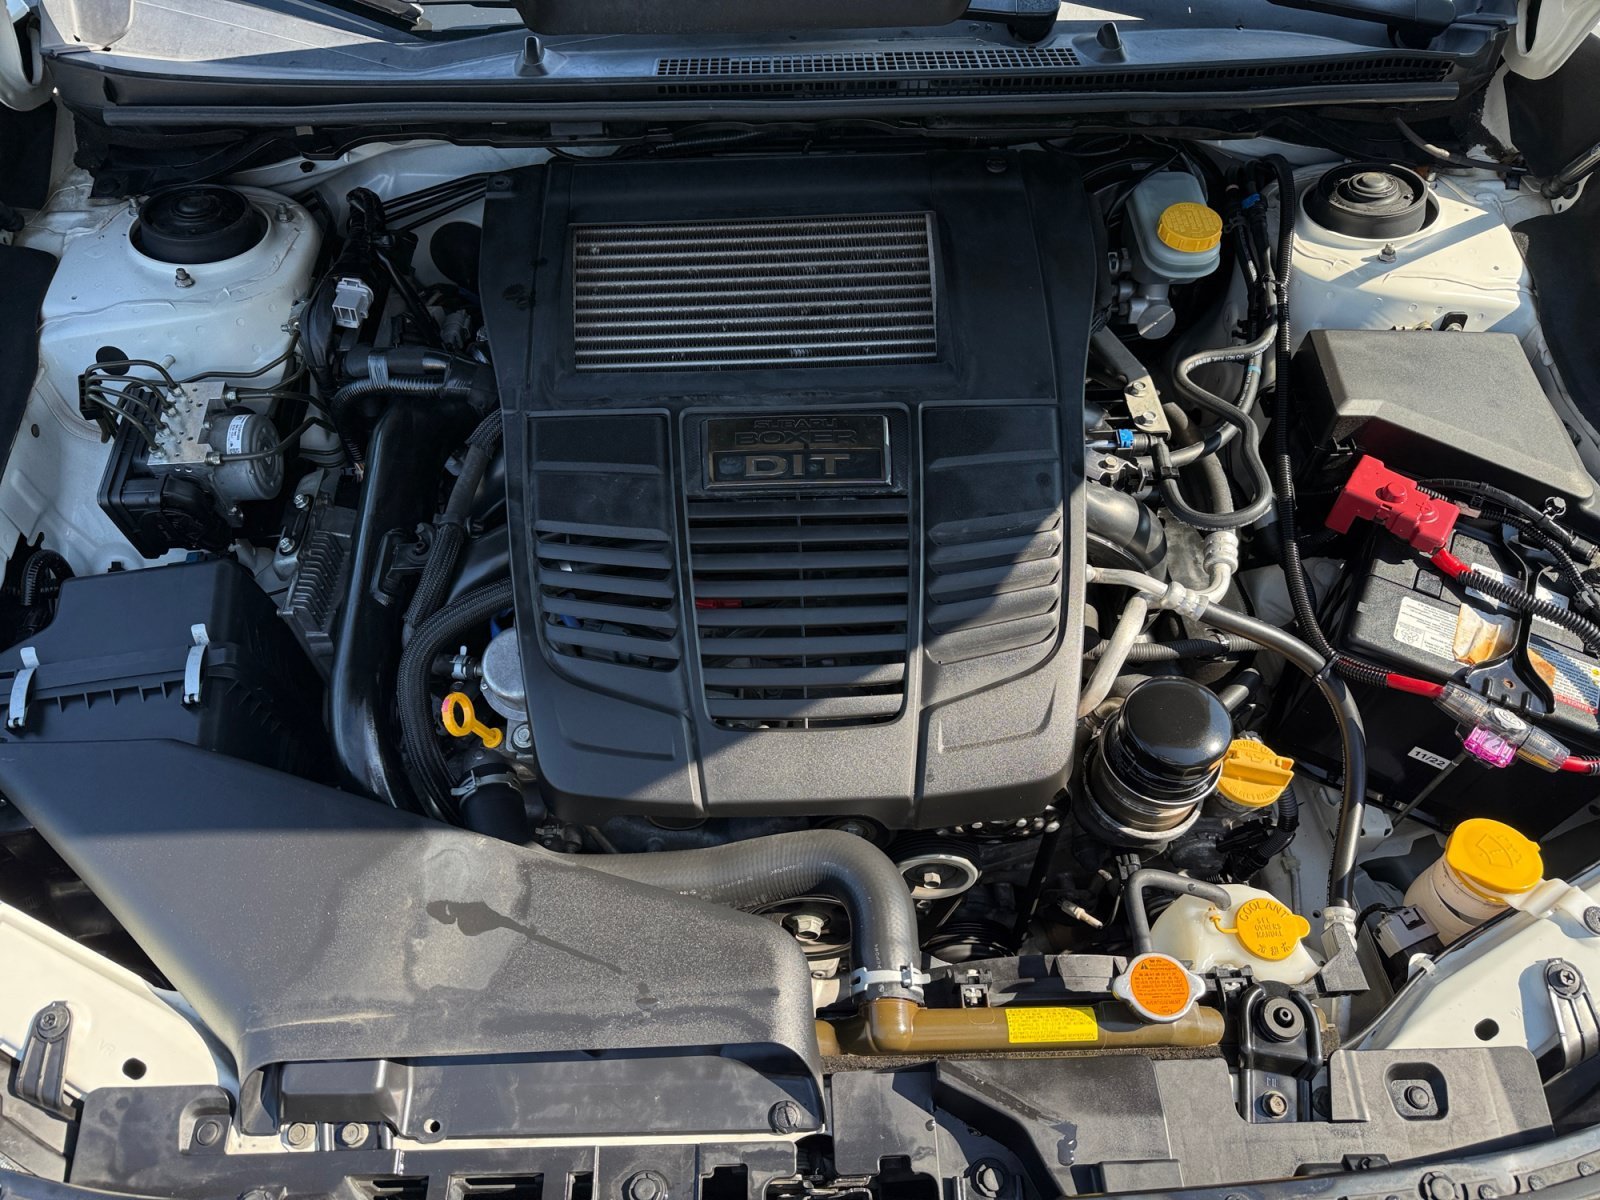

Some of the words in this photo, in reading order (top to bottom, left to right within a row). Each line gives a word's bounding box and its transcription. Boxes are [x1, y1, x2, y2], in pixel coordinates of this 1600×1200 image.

[754, 418, 837, 429] SUBARU
[735, 430, 857, 446] BOXER
[745, 453, 850, 477] DIT
[1414, 750, 1446, 767] 11/22
[1239, 901, 1290, 922] COOLANT
